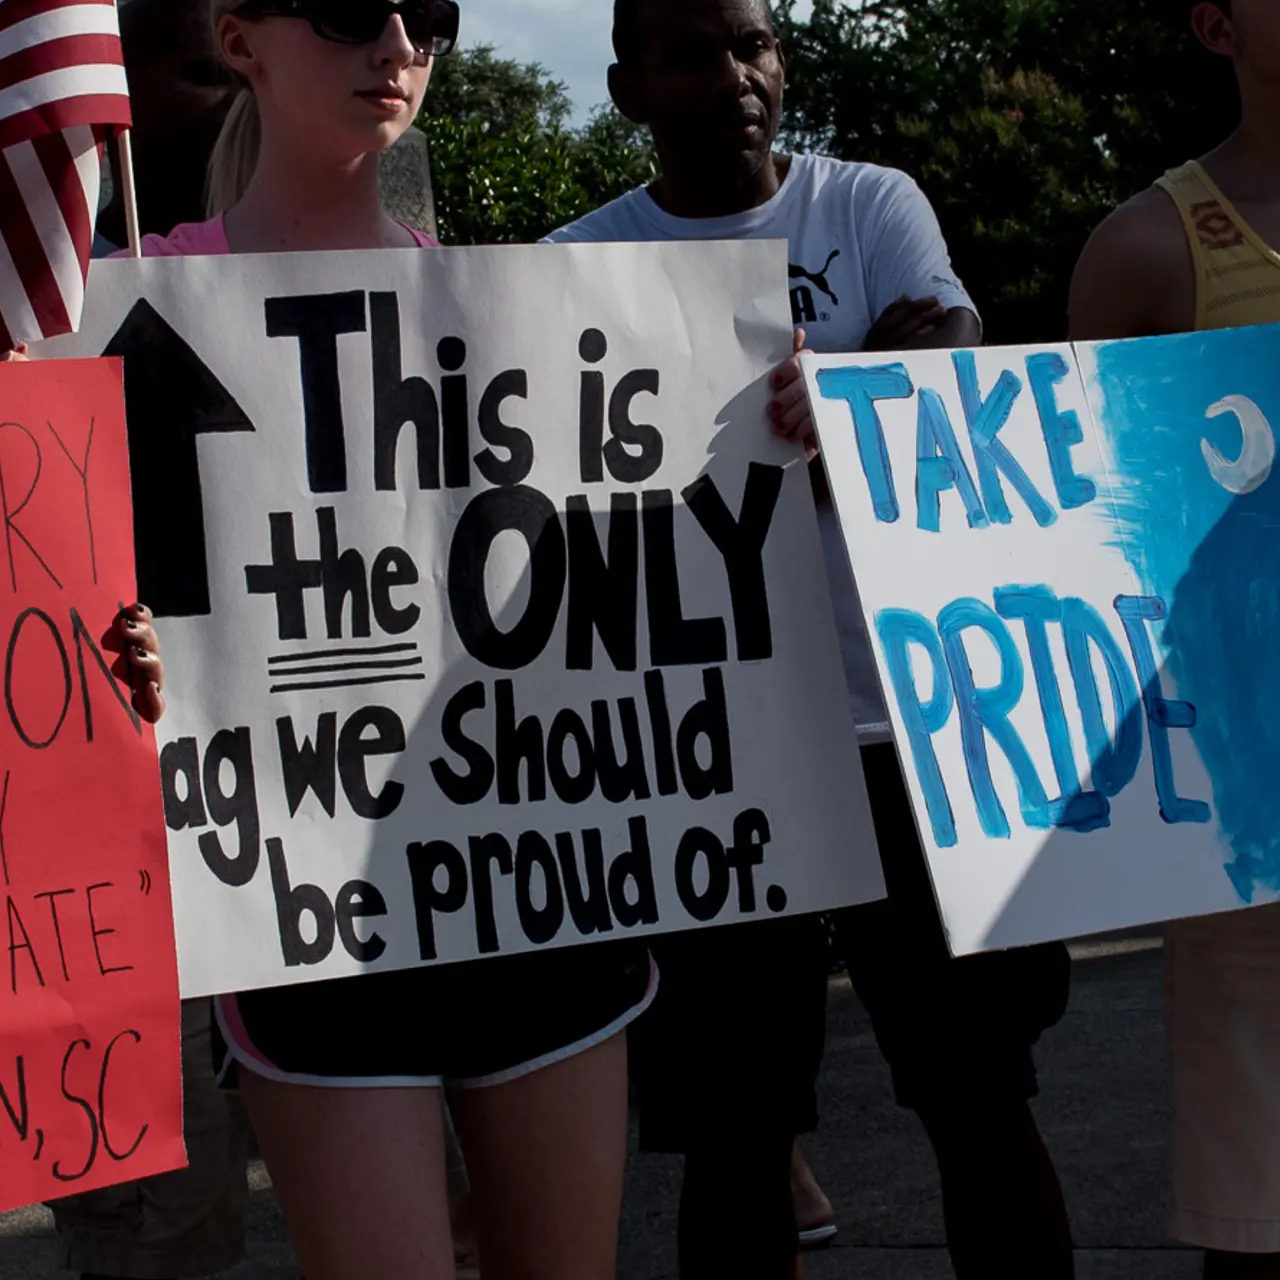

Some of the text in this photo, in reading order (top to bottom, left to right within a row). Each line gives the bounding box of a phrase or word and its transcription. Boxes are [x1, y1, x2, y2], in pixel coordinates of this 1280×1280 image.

[264, 289, 665, 493] This is
[815, 349, 1099, 533] TAKE
[245, 460, 785, 671] the ONLY
[276, 704, 406, 821] we
[874, 582, 1211, 848] PRIDE
[265, 807, 788, 968] be proud of.
[51, 1027, 150, 1184] SC
